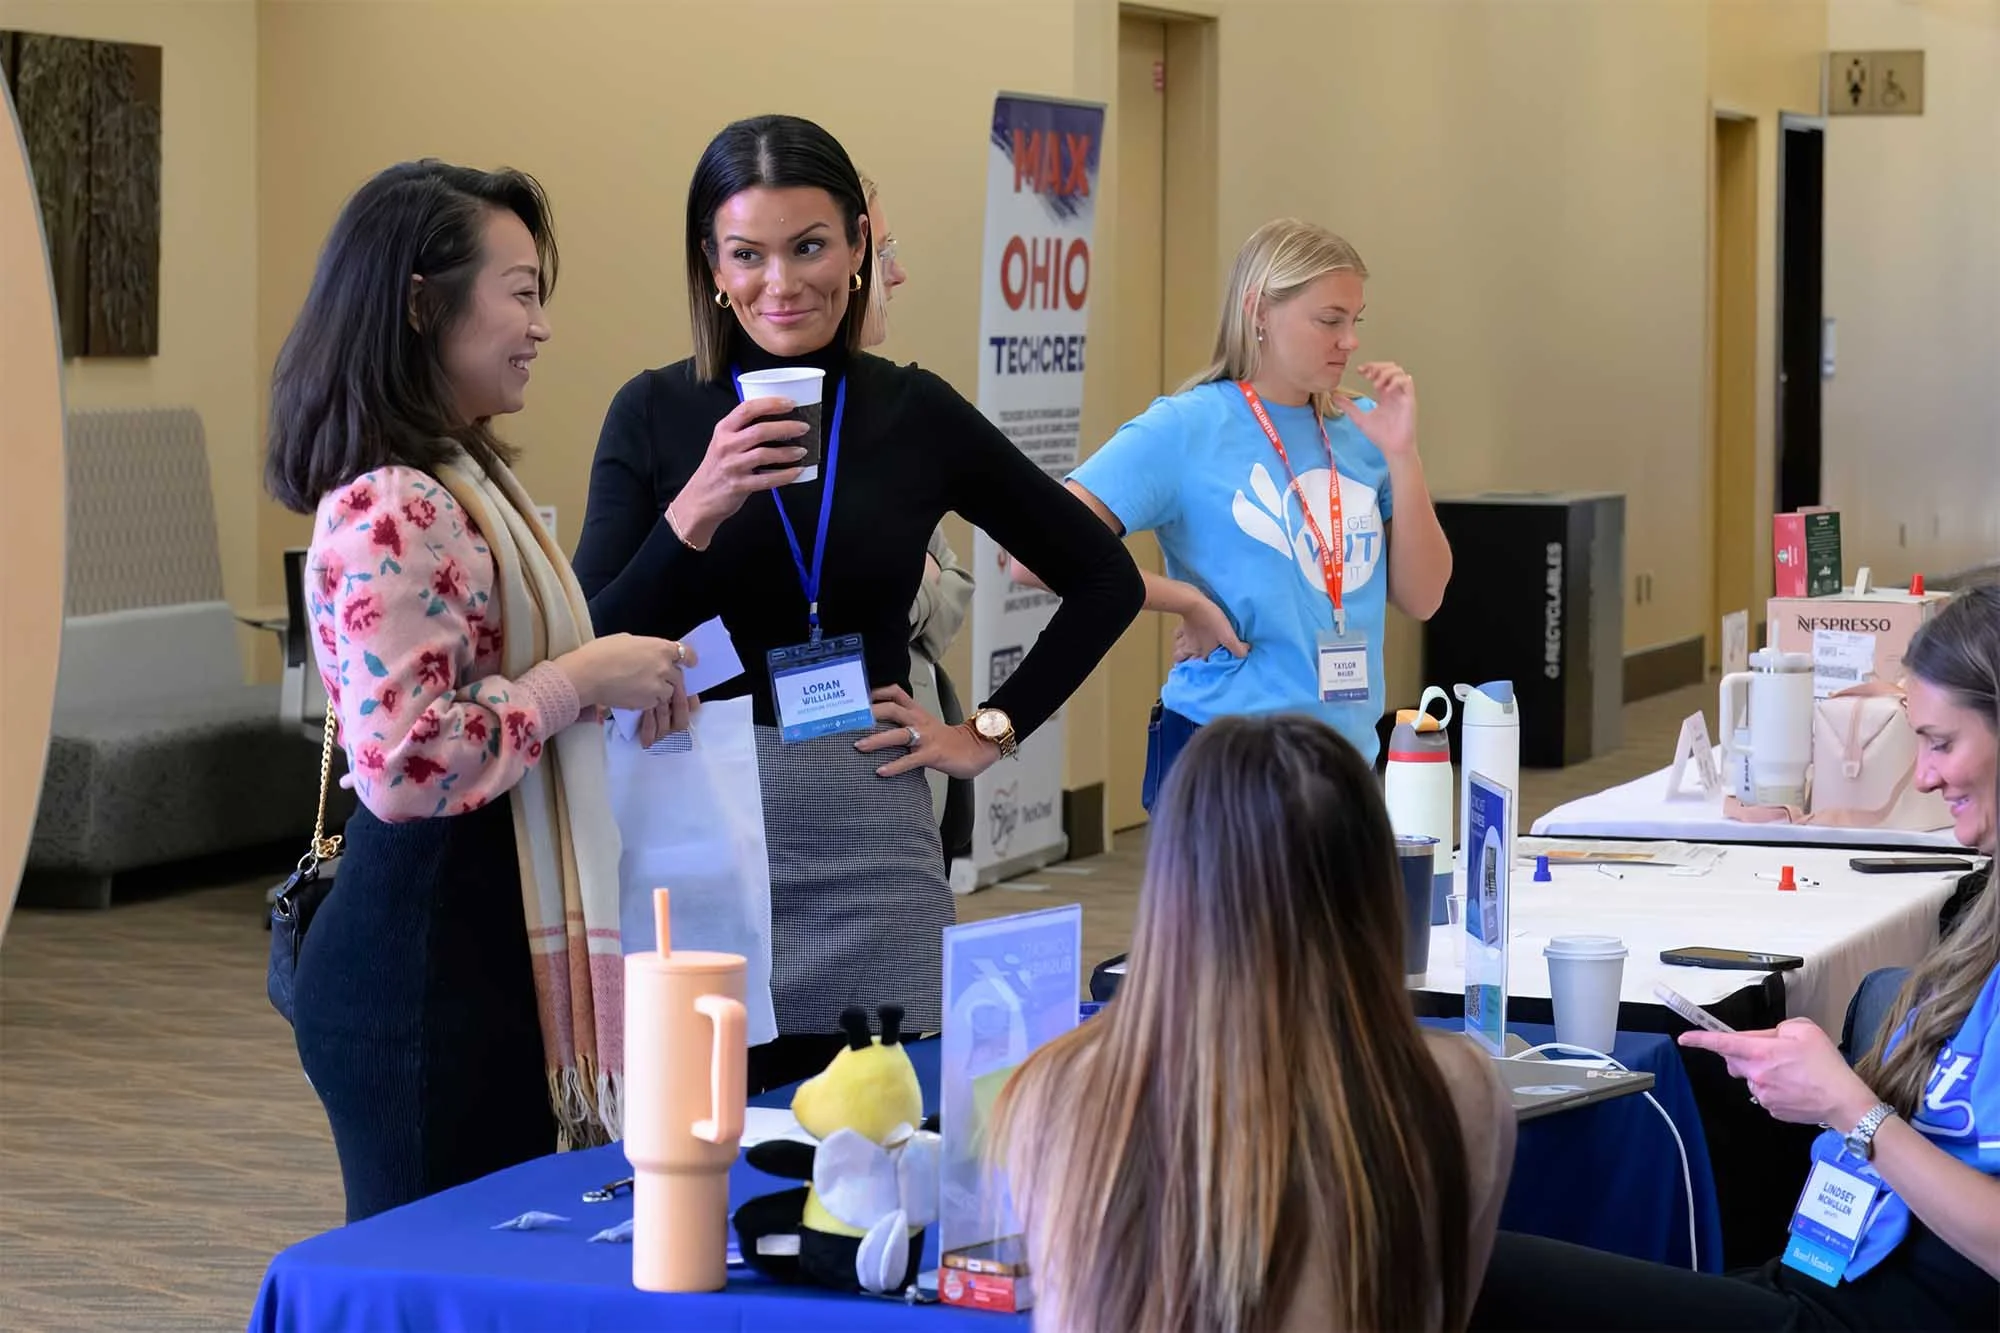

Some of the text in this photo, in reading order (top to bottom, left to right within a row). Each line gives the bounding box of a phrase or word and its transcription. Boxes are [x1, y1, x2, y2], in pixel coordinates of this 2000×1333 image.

[1013, 127, 1091, 197] MAX
[1000, 235, 1089, 312] OHIO
[1252, 401, 1278, 443] VOLUNTEER
[1333, 519, 1342, 565] VOLUNTEER
[1545, 542, 1562, 663] RECYCLABLES
[1795, 614, 1891, 632] NESPRESSO
[1333, 661, 1356, 670] TAYLOR
[801, 690, 846, 705] WILLIAMS
[802, 680, 841, 696] LORAN
[1822, 1182, 1857, 1204] LINDSEY
